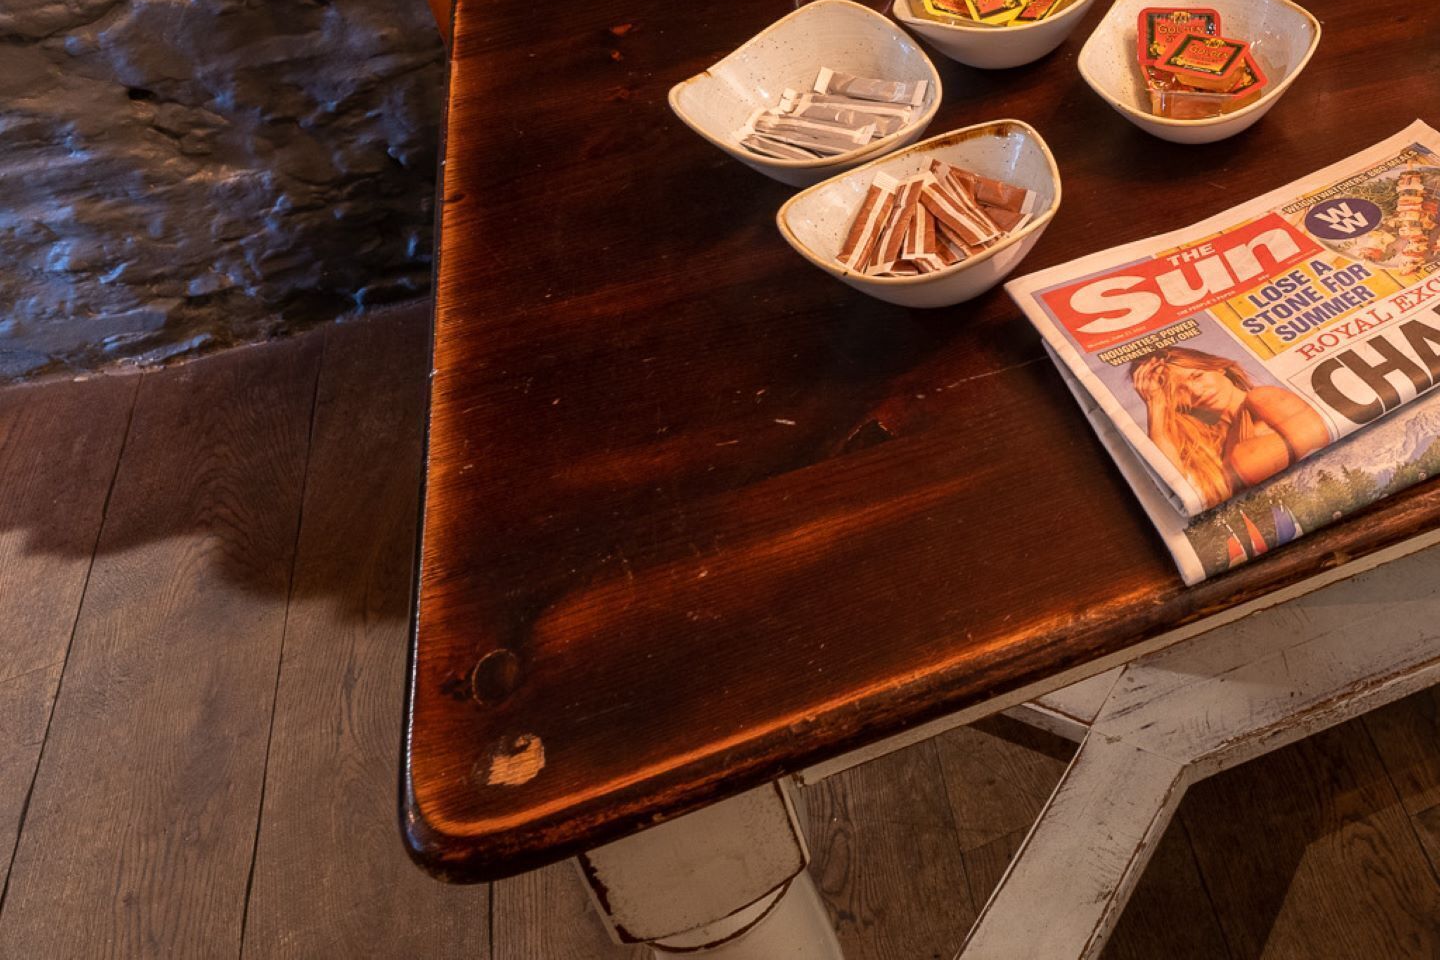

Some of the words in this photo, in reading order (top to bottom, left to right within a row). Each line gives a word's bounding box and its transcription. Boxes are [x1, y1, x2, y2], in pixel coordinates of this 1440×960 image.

[1166, 243, 1216, 267] THE
[1242, 285, 1324, 335] STONE
[1320, 262, 1372, 293] FOR
[1248, 269, 1311, 309] LOSE
[1309, 259, 1333, 276] A
[1275, 285, 1376, 341] SUMMER
[1295, 308, 1394, 361] ROYAL
[1099, 333, 1160, 361] NOUGHTIES
[1160, 319, 1198, 339] POWER
[1155, 337, 1176, 350] DAY
[1177, 328, 1200, 341] ONE
